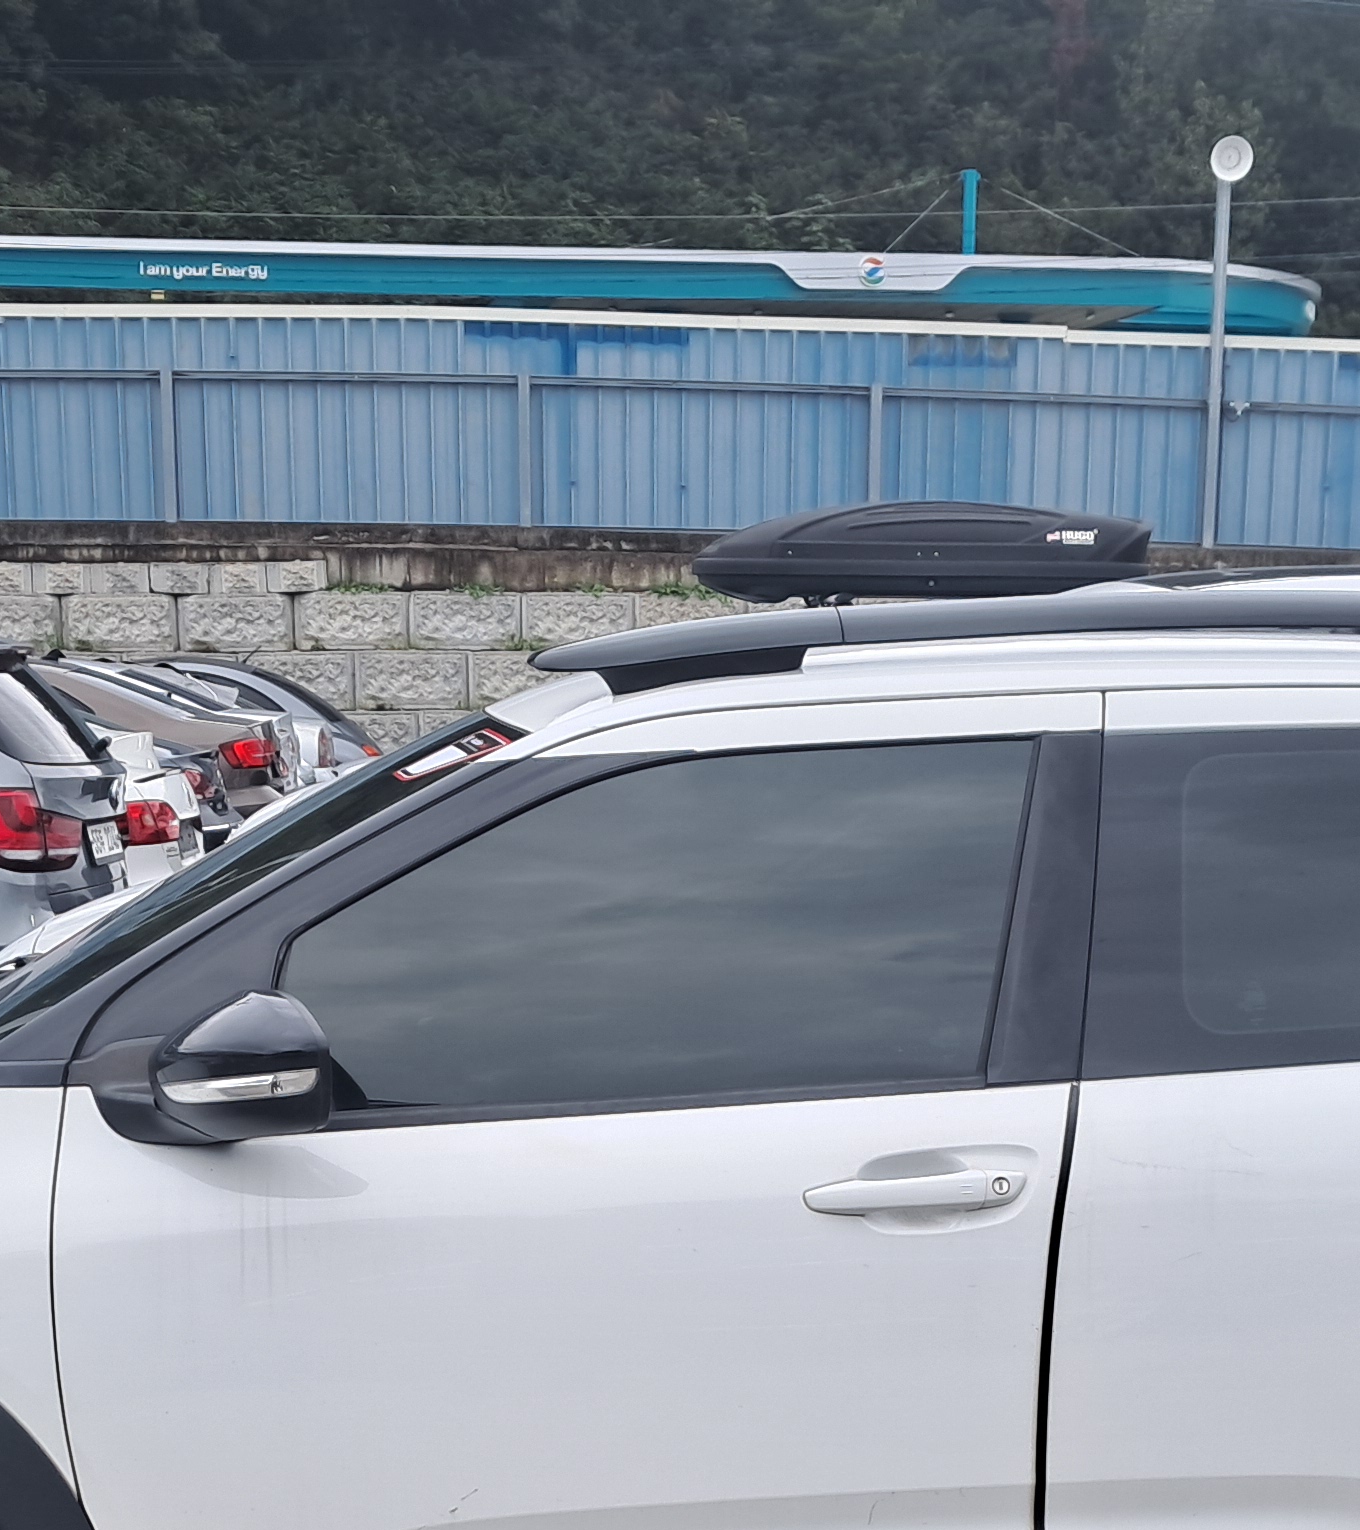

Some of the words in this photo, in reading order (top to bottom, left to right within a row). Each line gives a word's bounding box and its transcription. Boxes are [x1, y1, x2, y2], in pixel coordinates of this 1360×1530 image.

[139, 261, 144, 276] I
[146, 264, 171, 276] am
[172, 264, 210, 280] your
[211, 262, 268, 280] Energy
